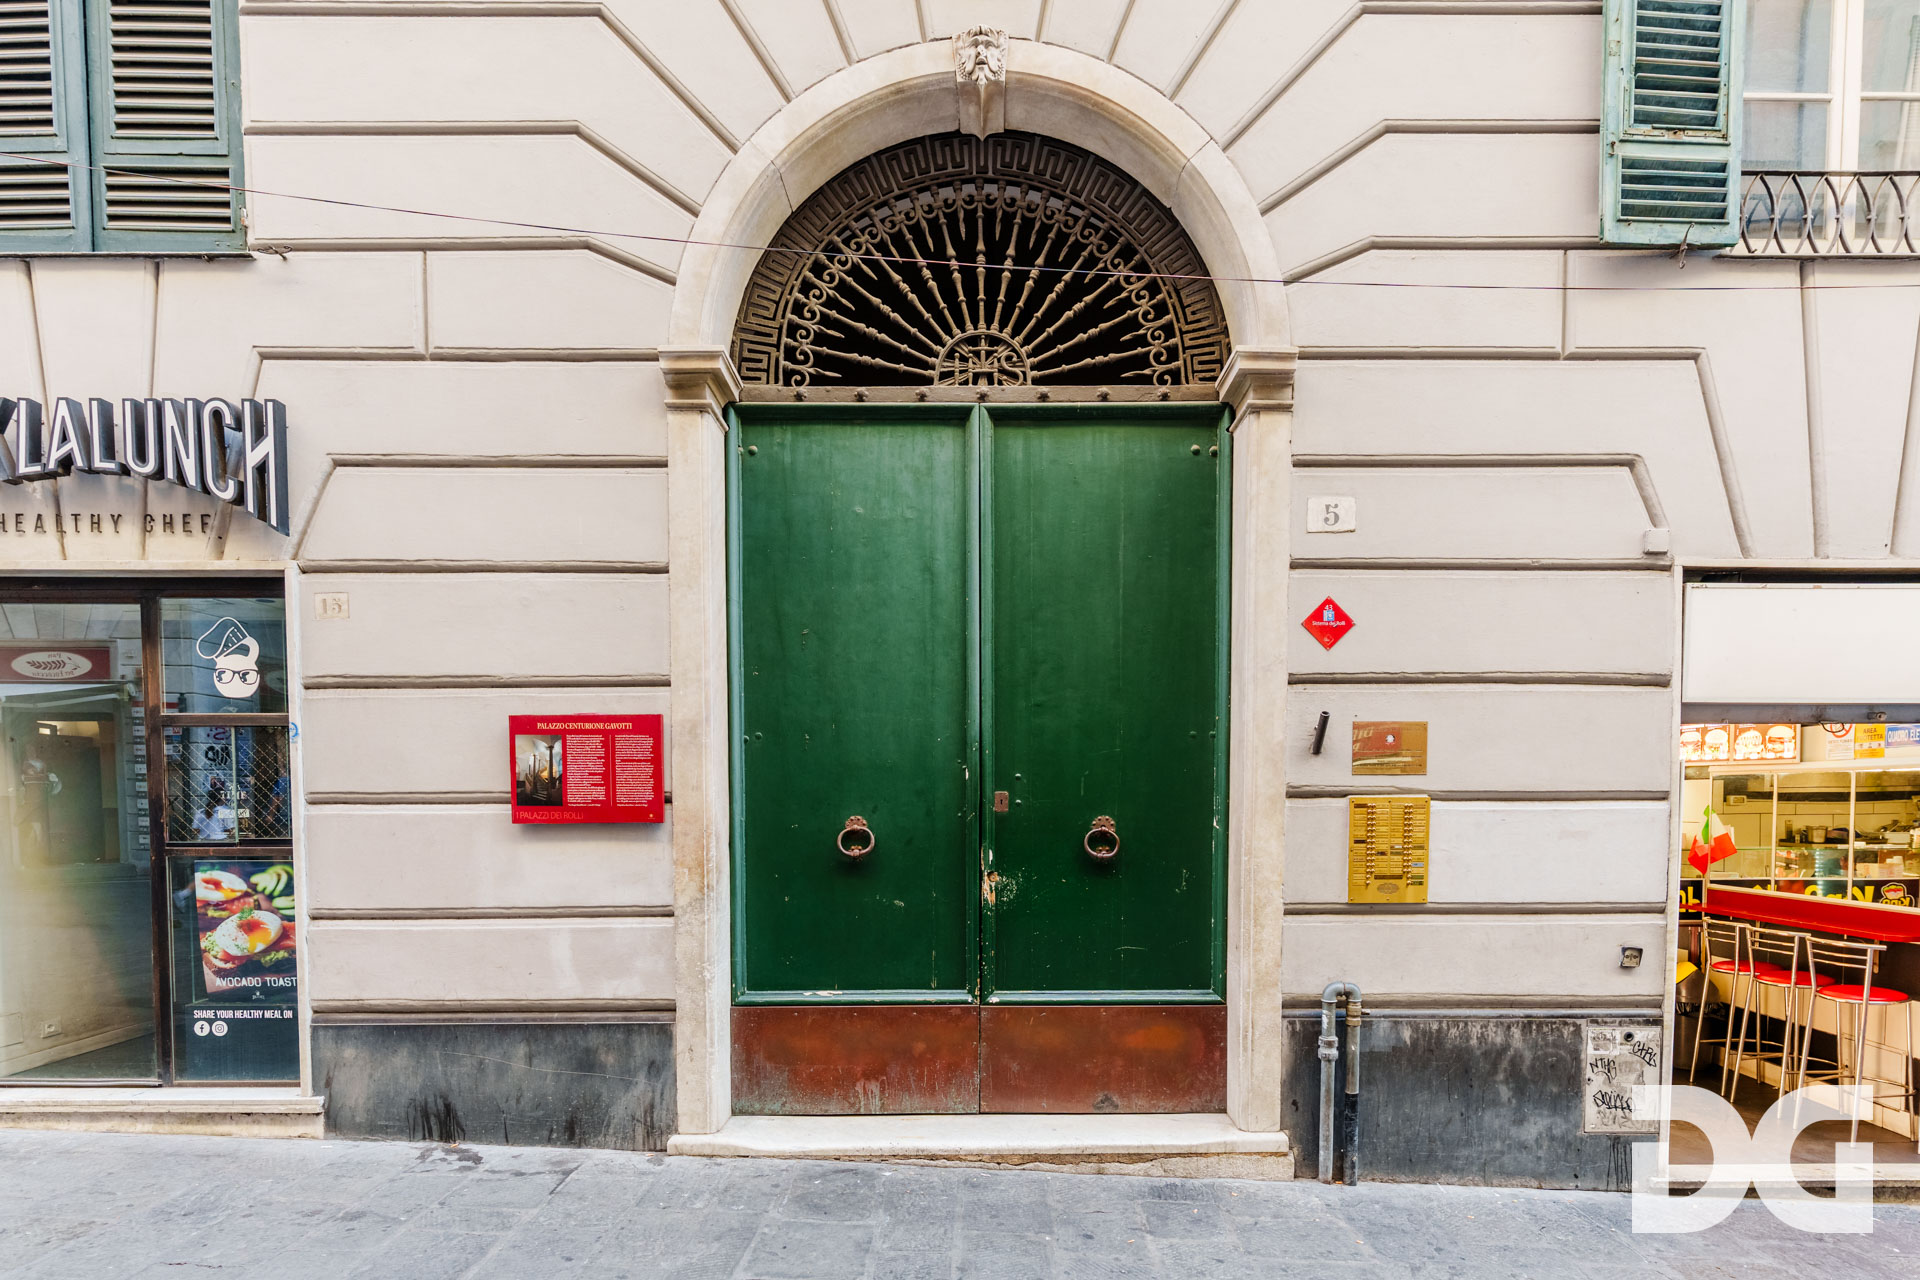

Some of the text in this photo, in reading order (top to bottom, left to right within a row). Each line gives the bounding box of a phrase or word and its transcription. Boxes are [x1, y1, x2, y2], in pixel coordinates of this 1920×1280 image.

[1323, 503, 1340, 526] 5
[144, 513, 212, 534] CHEF
[519, 811, 549, 820] PALAZZI
[550, 811, 563, 820] DEI
[563, 811, 584, 820] ROLLI
[215, 977, 297, 987] AVOCADO TOAST
[193, 1010, 293, 1019] SHARE YOUR HEALTHY MEAL ON
